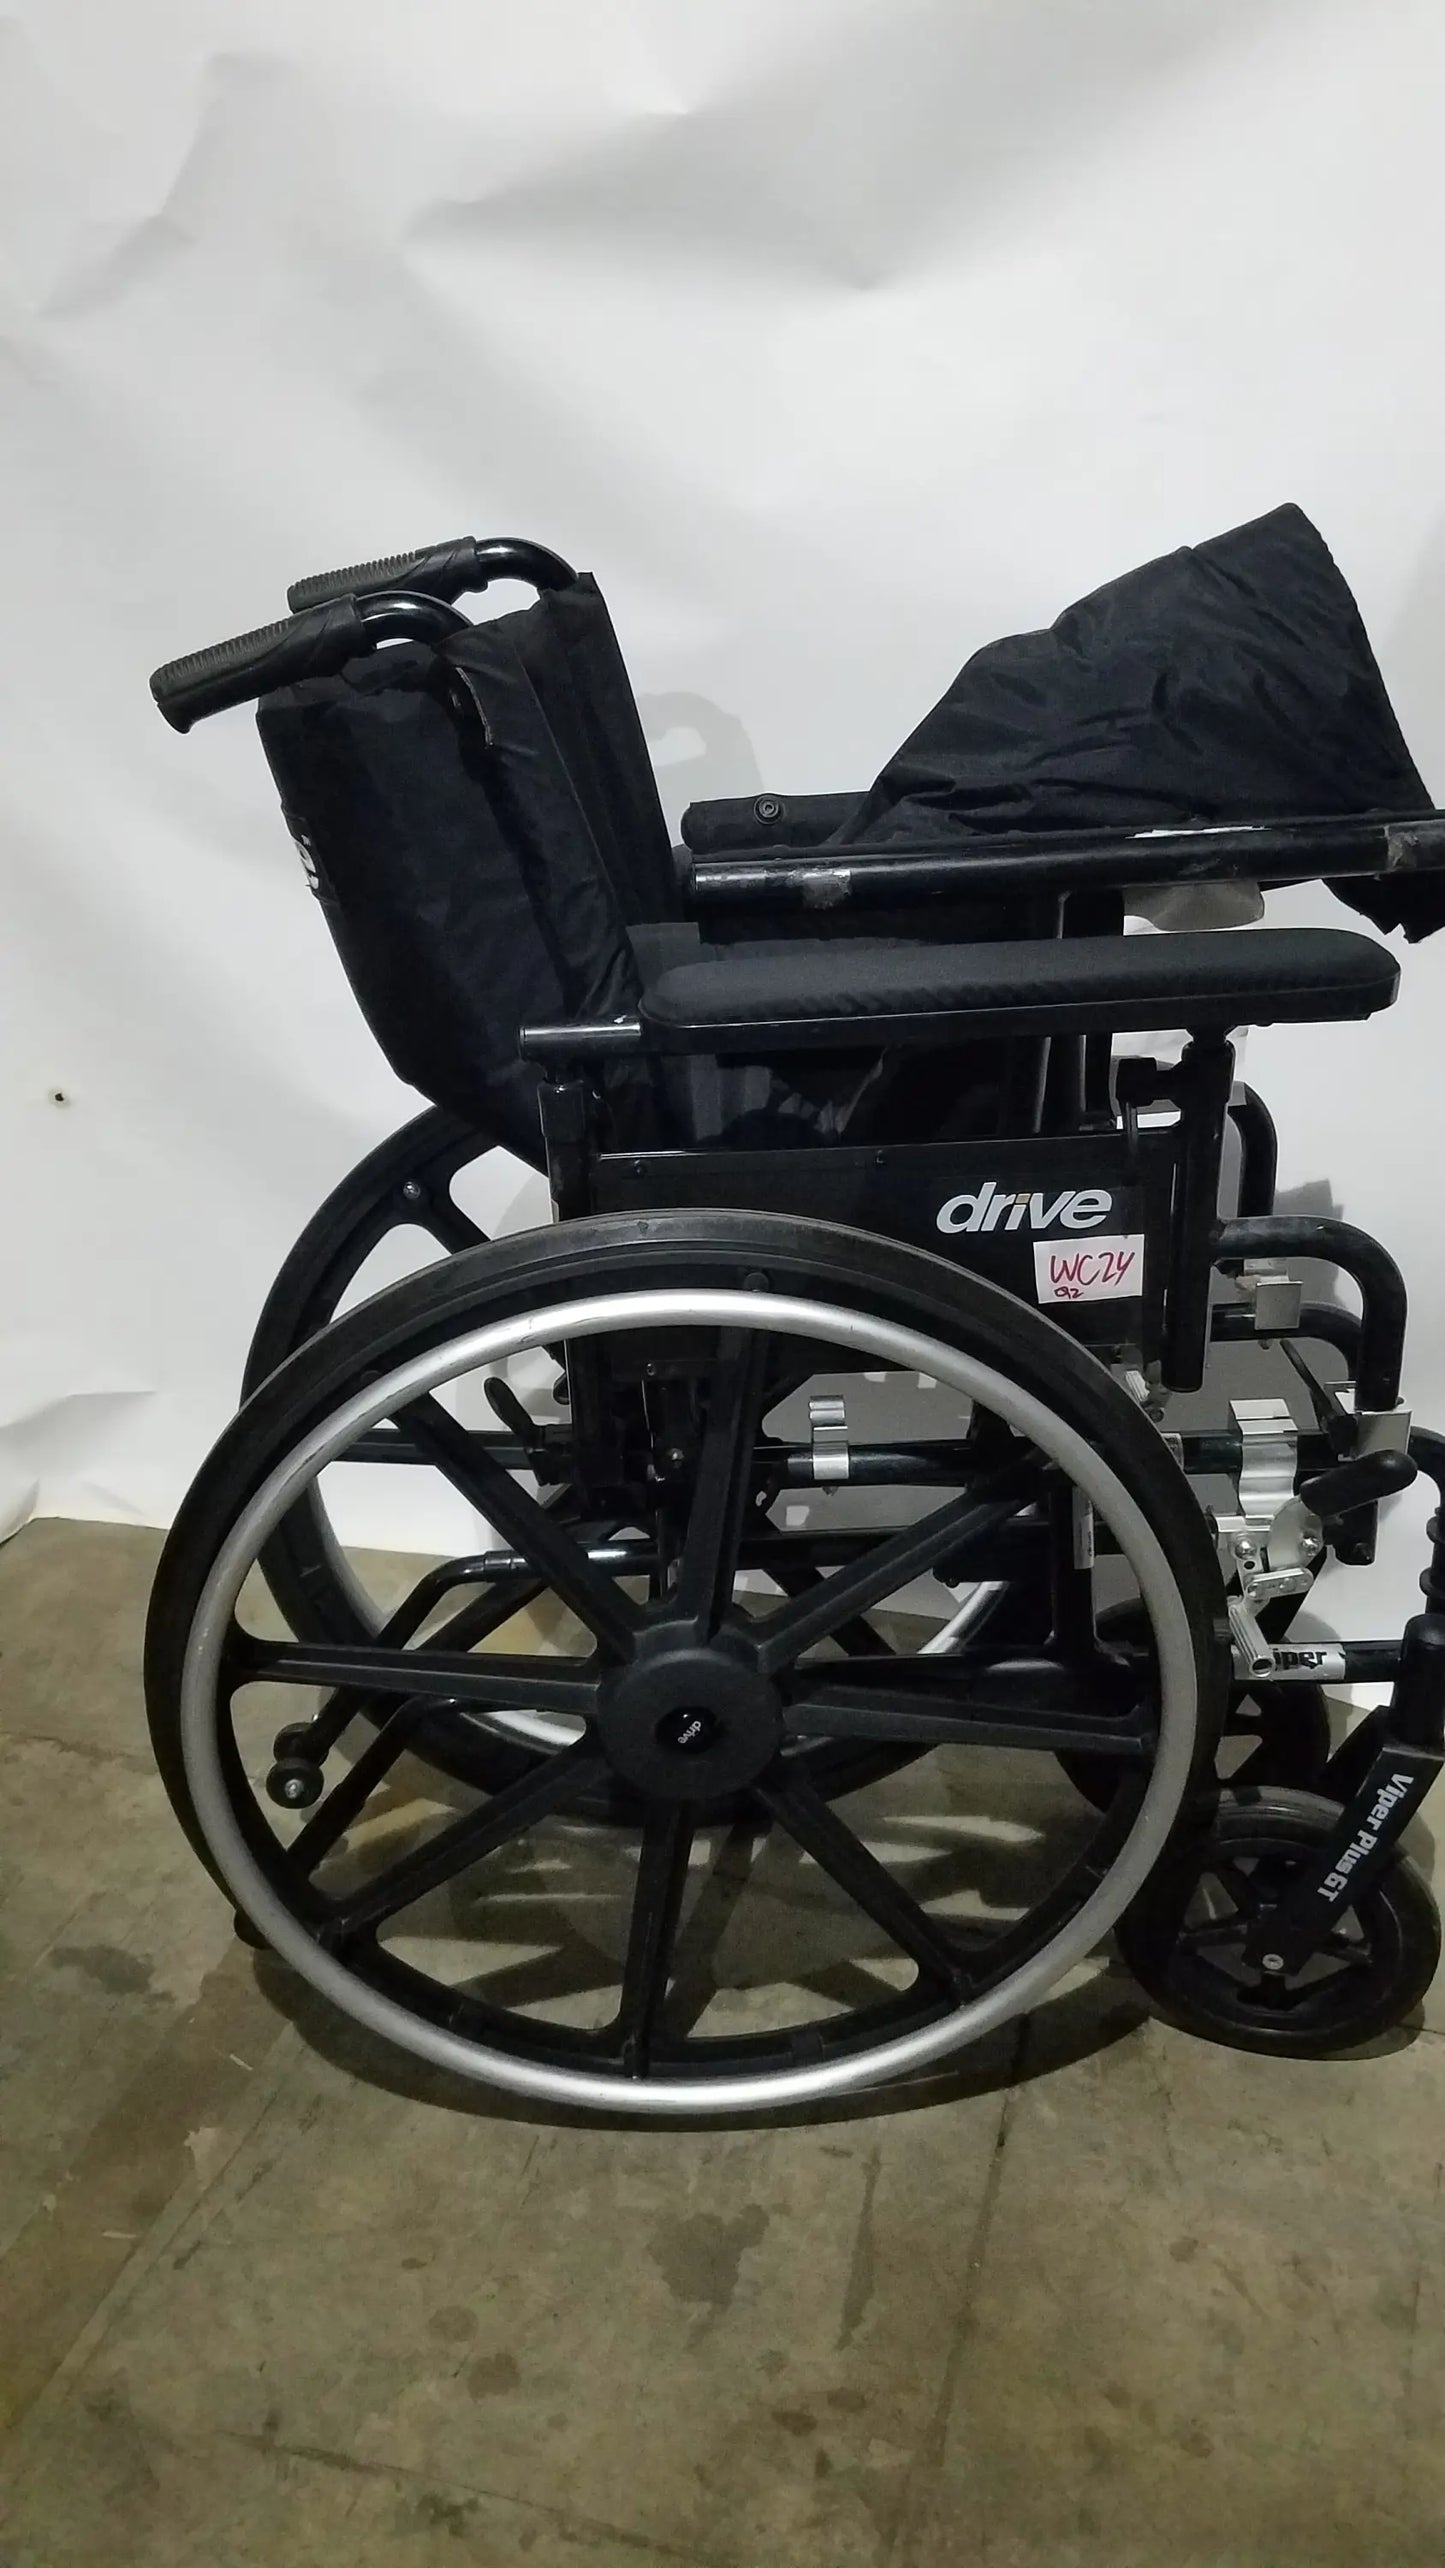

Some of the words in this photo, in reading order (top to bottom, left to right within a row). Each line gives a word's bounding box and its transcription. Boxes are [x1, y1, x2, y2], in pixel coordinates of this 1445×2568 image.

[936, 1182, 1112, 1234] drive
[1272, 1648, 1327, 1671] iper
[678, 1721, 702, 1744] drive
[1367, 1773, 1415, 1831] Viper
